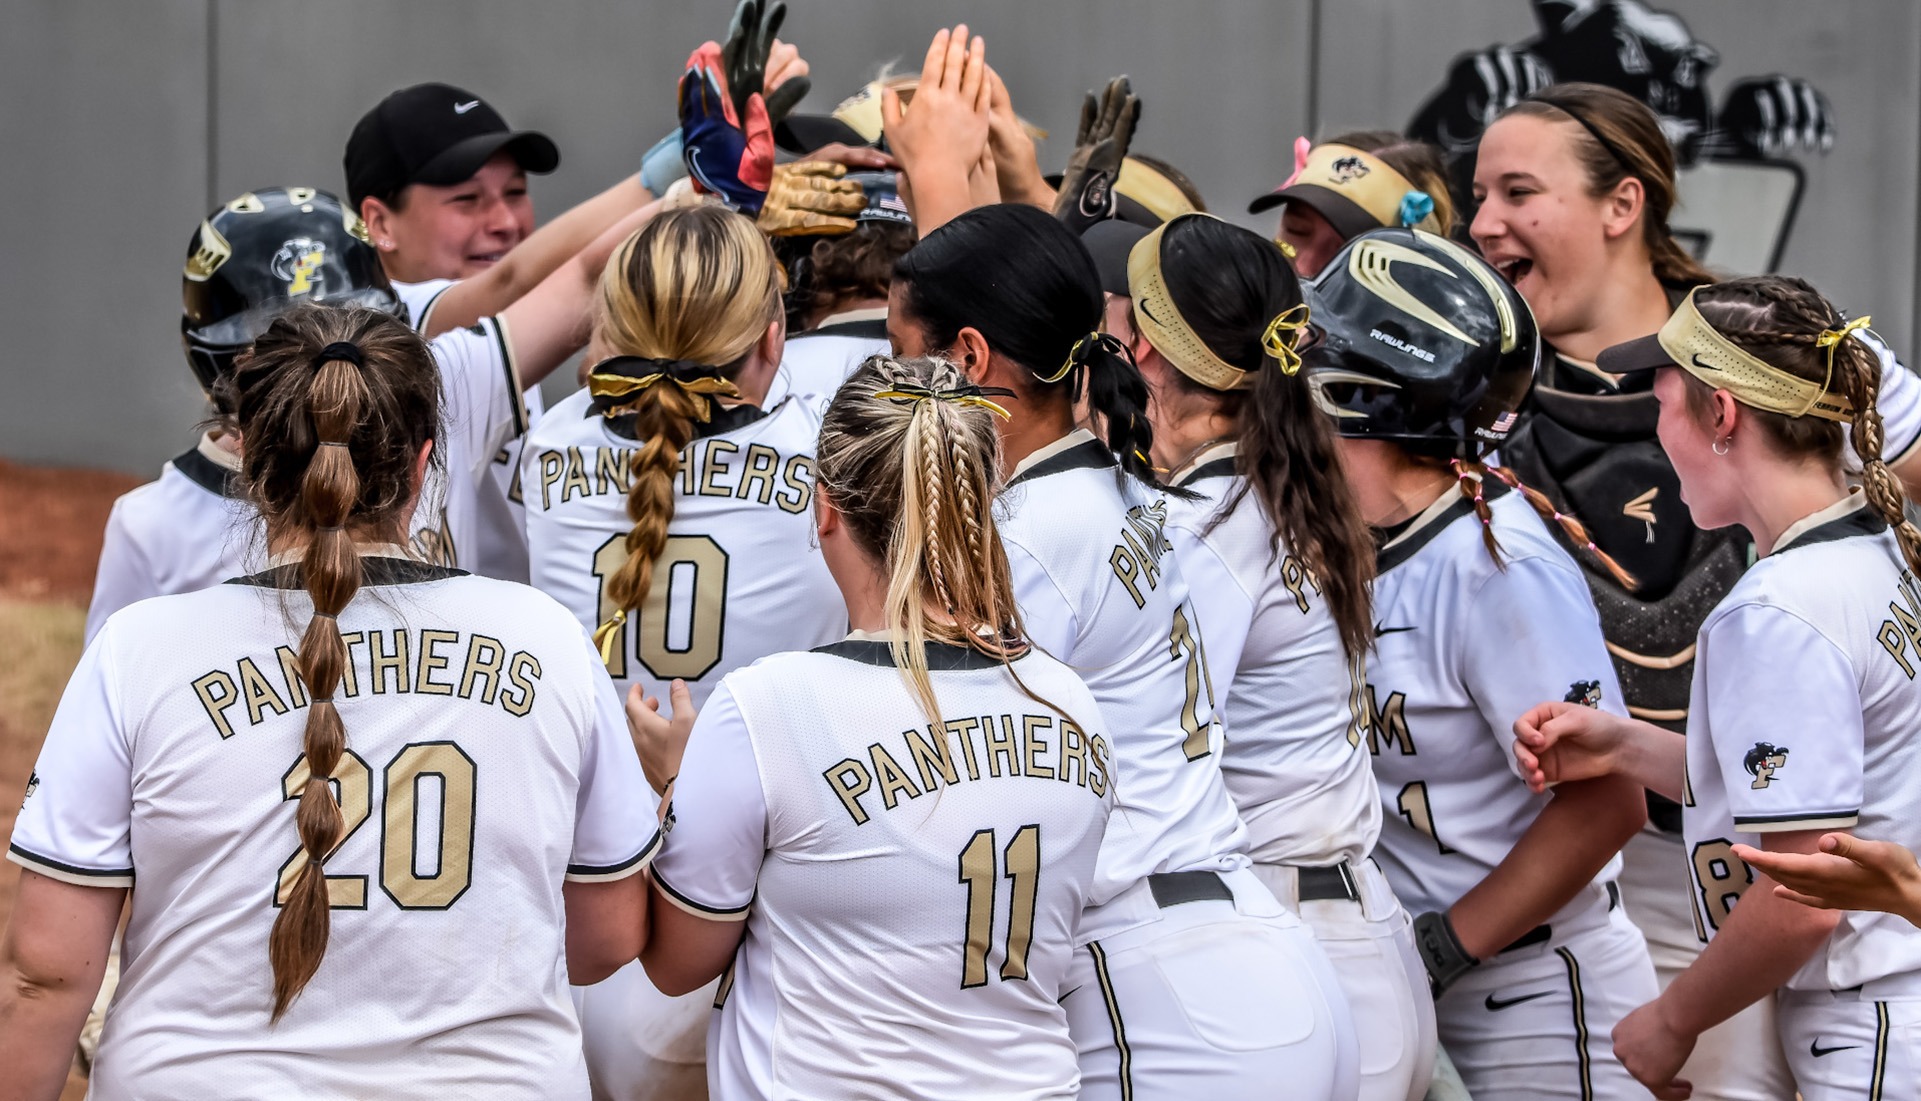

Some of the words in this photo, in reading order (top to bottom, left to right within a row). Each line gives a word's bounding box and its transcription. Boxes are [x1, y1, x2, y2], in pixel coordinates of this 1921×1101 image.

[1370, 328, 1436, 363] RAWLINGS
[539, 438, 813, 515] PANHERS
[591, 531, 730, 682] 10
[272, 740, 478, 911] 20
[822, 713, 1110, 827] PANTHERS
[958, 823, 1041, 990] 11
